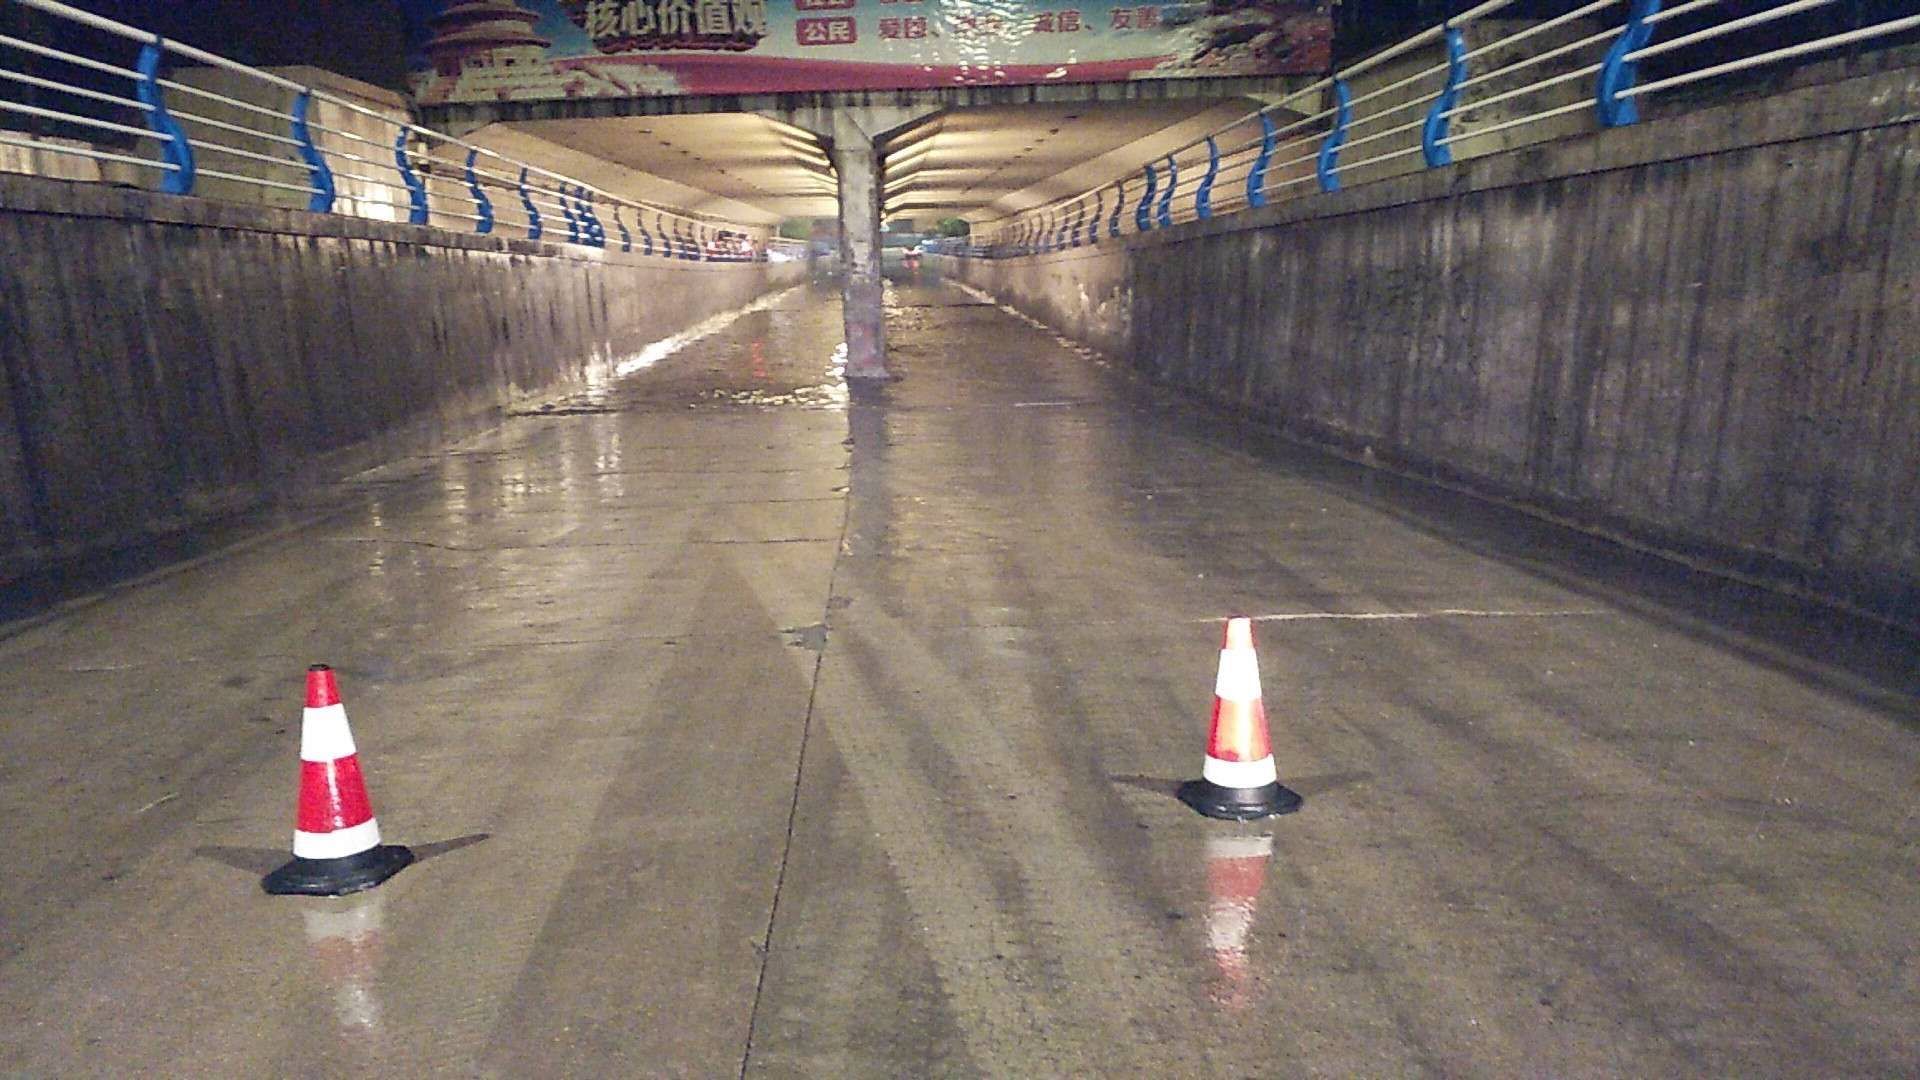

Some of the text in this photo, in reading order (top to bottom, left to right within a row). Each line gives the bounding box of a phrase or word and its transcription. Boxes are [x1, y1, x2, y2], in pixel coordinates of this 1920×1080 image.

[586, 0, 767, 38] 核心价值观
[805, 21, 851, 41] 公民
